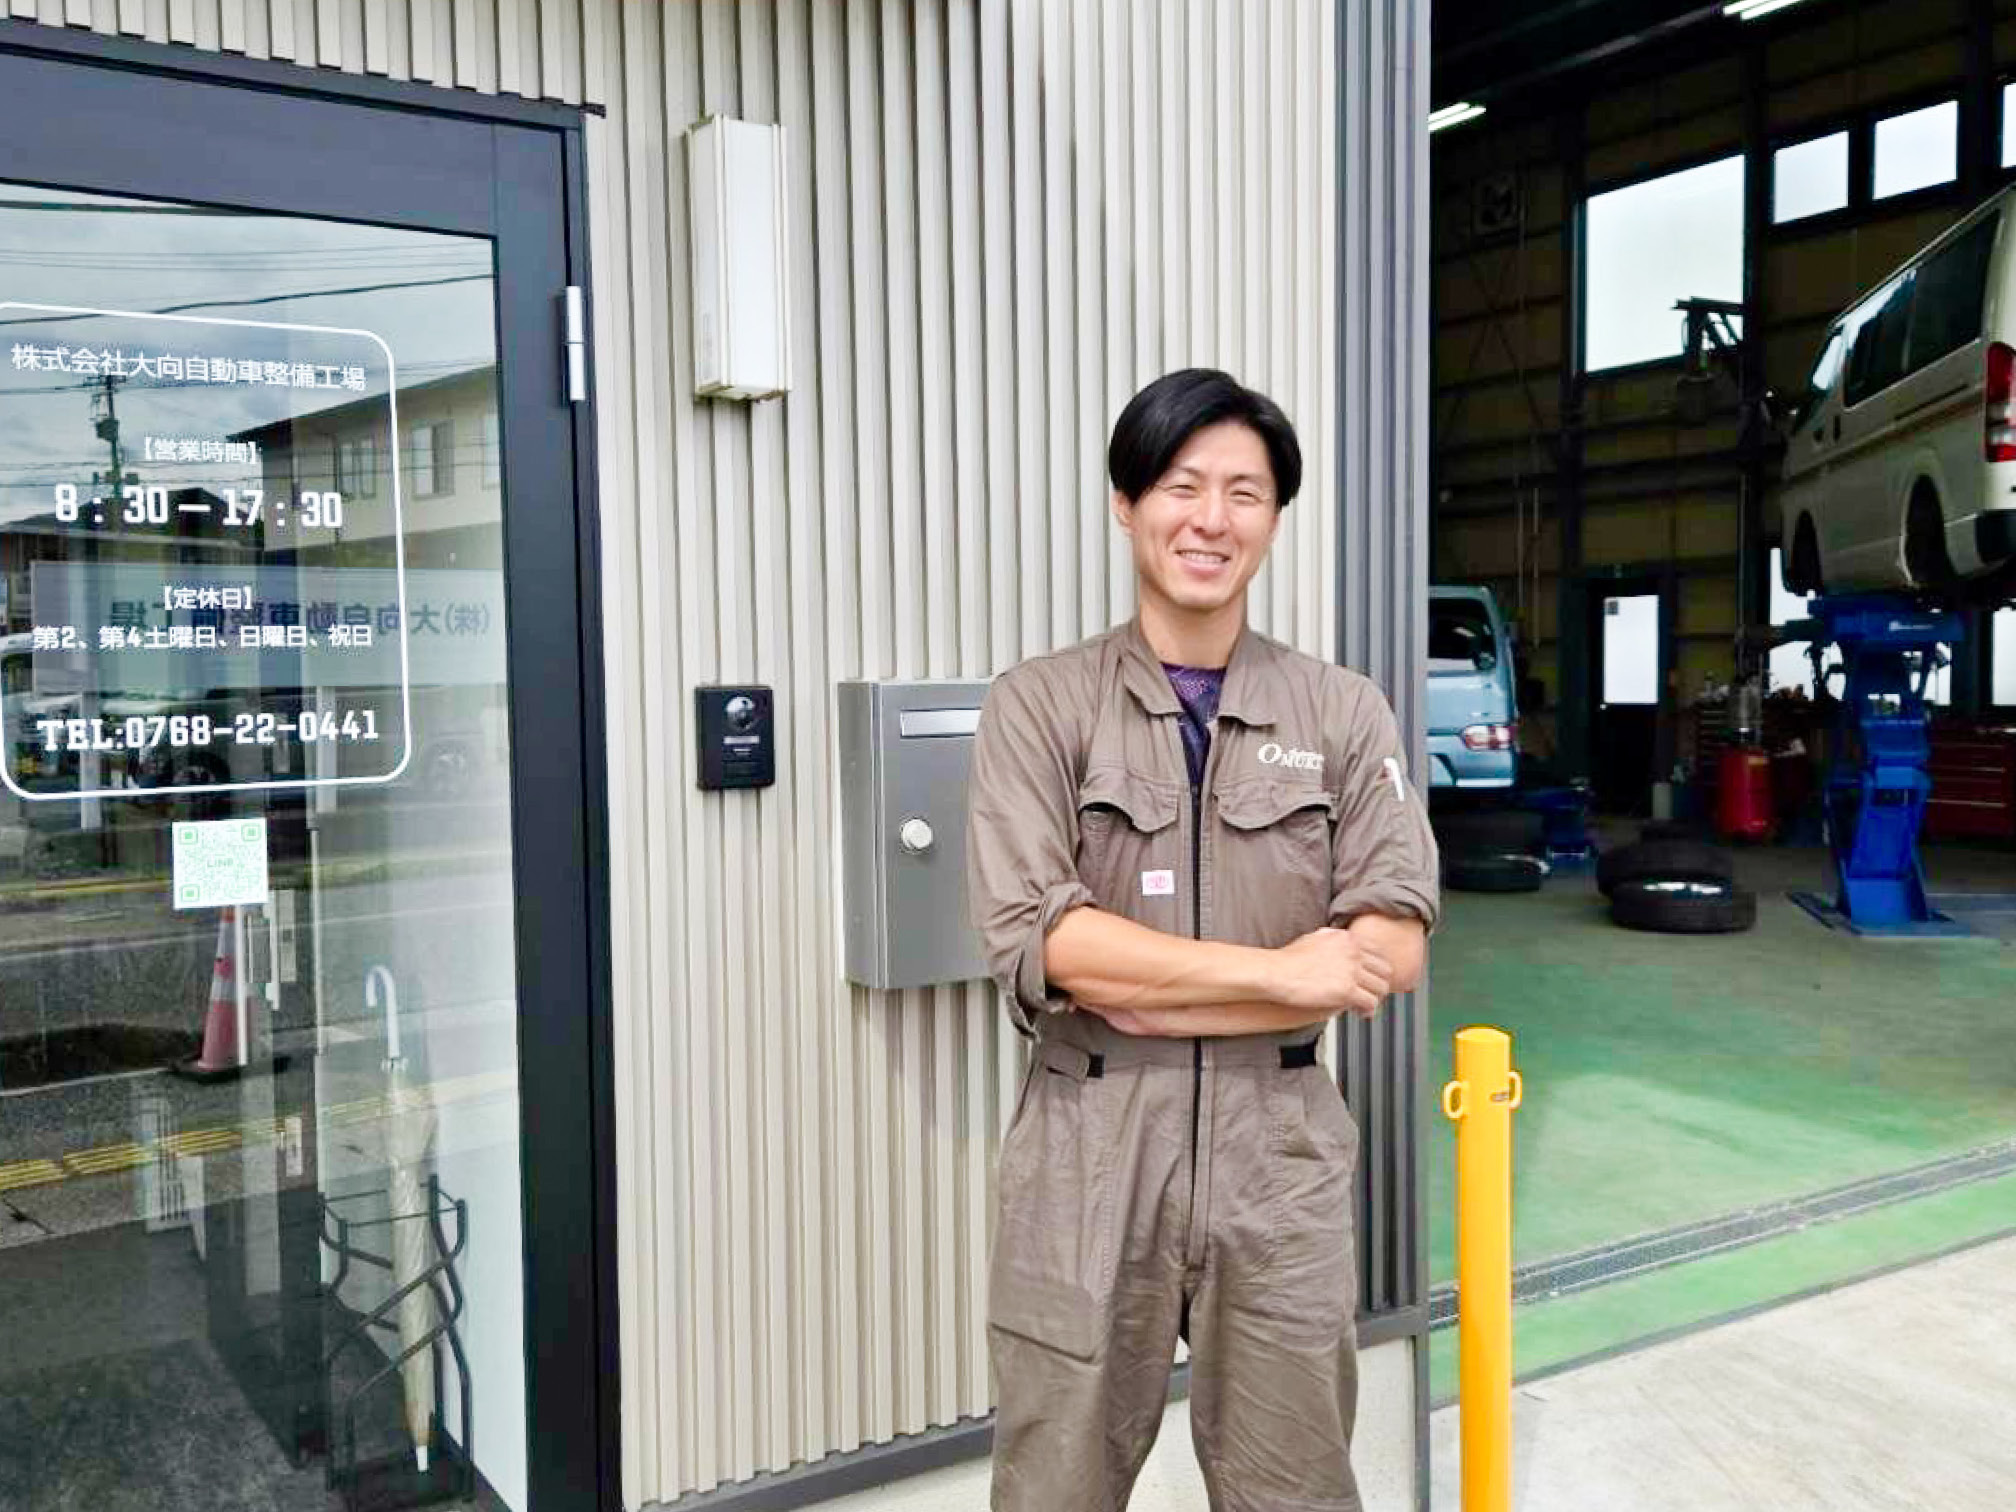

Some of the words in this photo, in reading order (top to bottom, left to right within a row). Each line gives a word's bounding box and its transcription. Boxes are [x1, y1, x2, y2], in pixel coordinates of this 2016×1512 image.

[11, 342, 366, 392] 株式会社大向自動車整備工場
